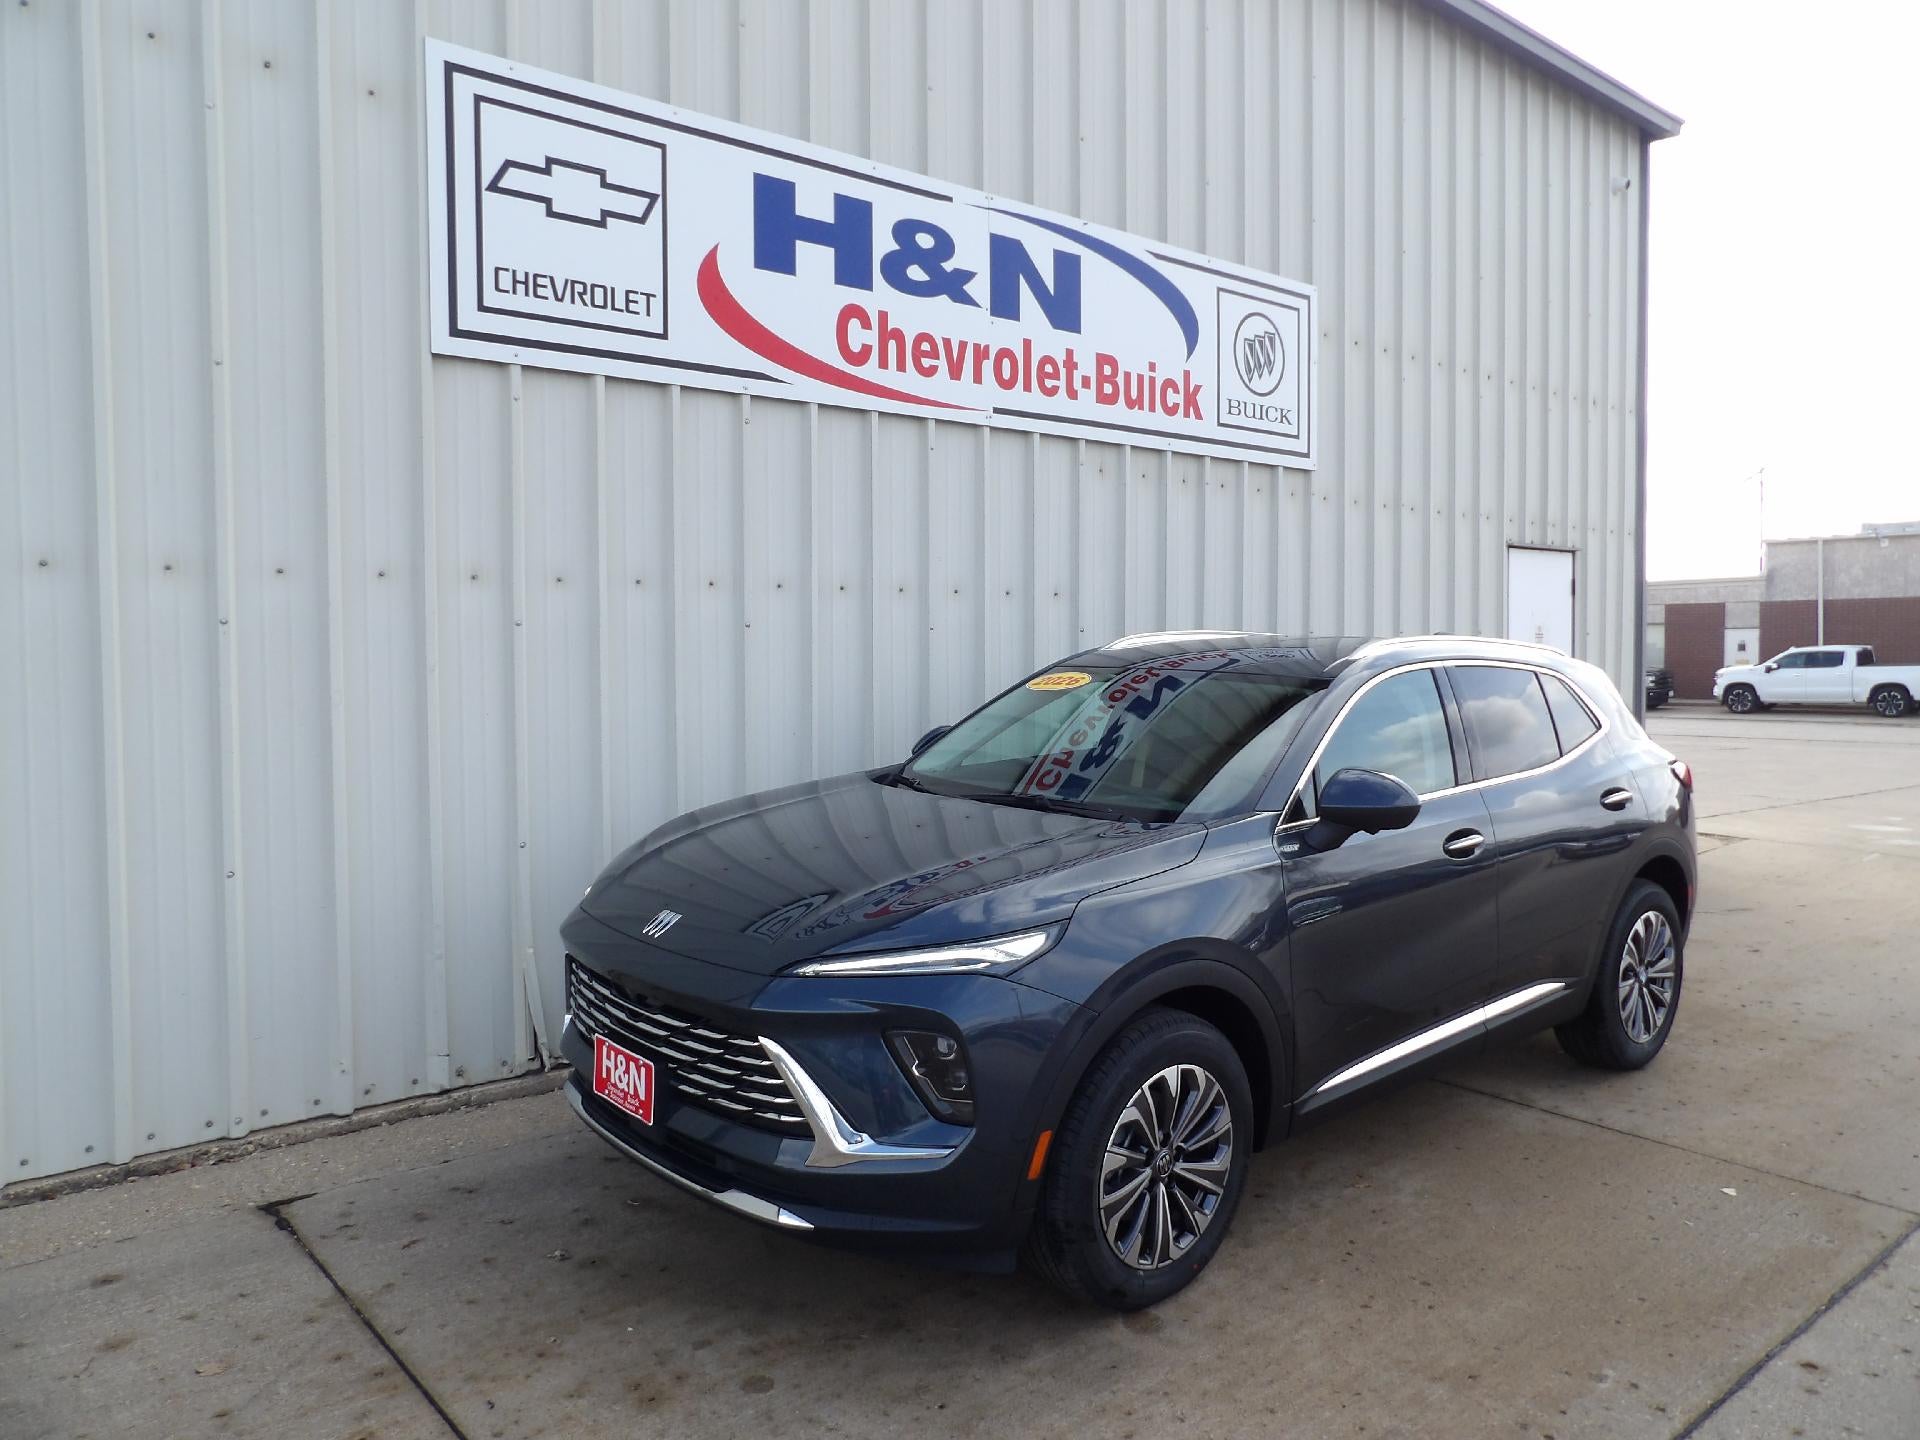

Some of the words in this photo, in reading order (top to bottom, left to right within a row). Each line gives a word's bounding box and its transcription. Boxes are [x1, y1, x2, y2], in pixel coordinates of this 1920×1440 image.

[753, 172, 1082, 335] H&N
[494, 266, 657, 318] CHEVROLET
[1226, 398, 1293, 426] BUICK
[1031, 675, 1086, 686] 2026
[602, 1044, 646, 1101] H&N
